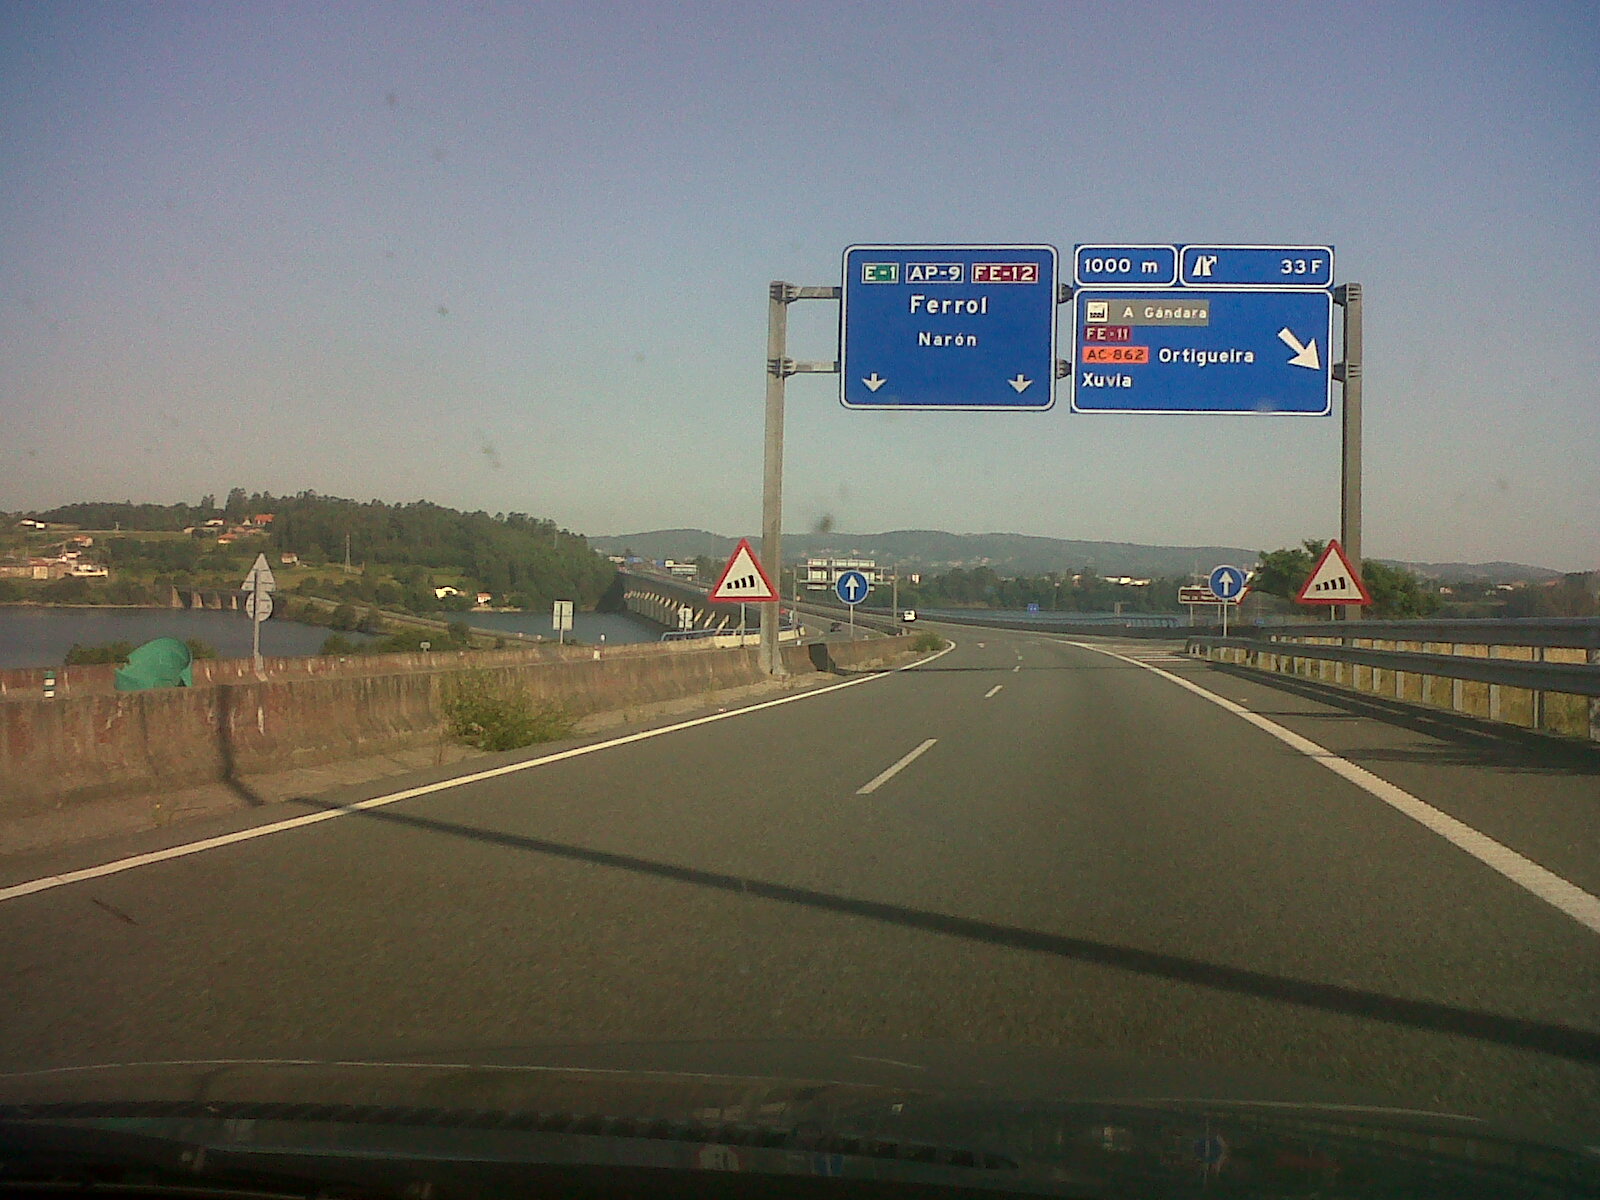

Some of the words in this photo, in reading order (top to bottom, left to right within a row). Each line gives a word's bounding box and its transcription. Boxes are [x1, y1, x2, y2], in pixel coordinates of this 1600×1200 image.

[1084, 258, 1131, 273] 1000
[1141, 261, 1158, 273] m
[864, 267, 896, 281] E-1
[909, 266, 961, 281] AP-9
[974, 266, 1034, 281] FE-12
[910, 295, 988, 314] Ferrol
[1122, 307, 1134, 318] A
[919, 332, 978, 347] Narón
[1086, 328, 1129, 340] FE-11
[1087, 349, 1144, 361] AC-862
[1158, 348, 1254, 366] Ortigueira
[1082, 373, 1132, 388] Xuvia
